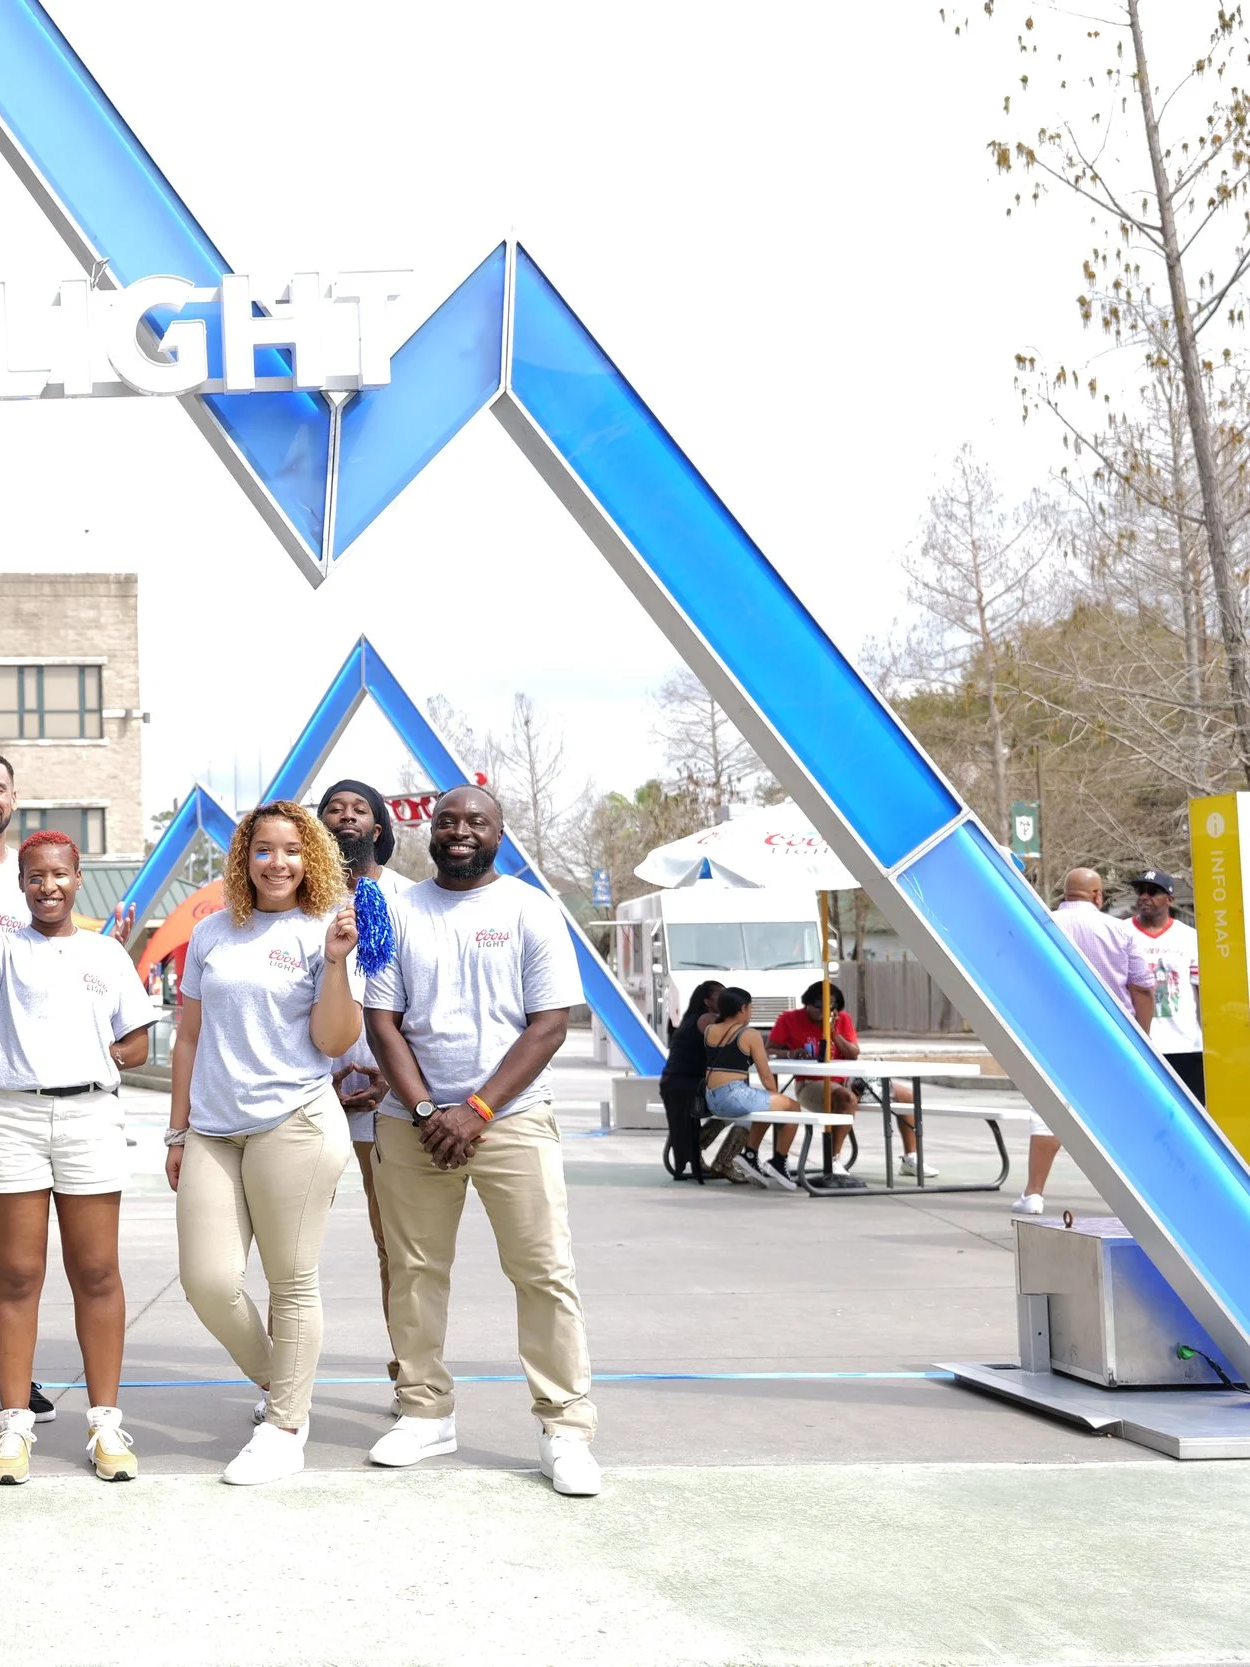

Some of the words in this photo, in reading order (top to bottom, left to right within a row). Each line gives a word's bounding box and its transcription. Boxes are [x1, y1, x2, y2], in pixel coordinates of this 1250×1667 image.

[1210, 850, 1227, 902] INFO
[475, 929, 510, 942] Coors
[1213, 909, 1230, 958] MAP
[478, 940, 505, 948] LIGHT
[269, 949, 302, 968] Coors
[269, 960, 296, 973] LIGHT
